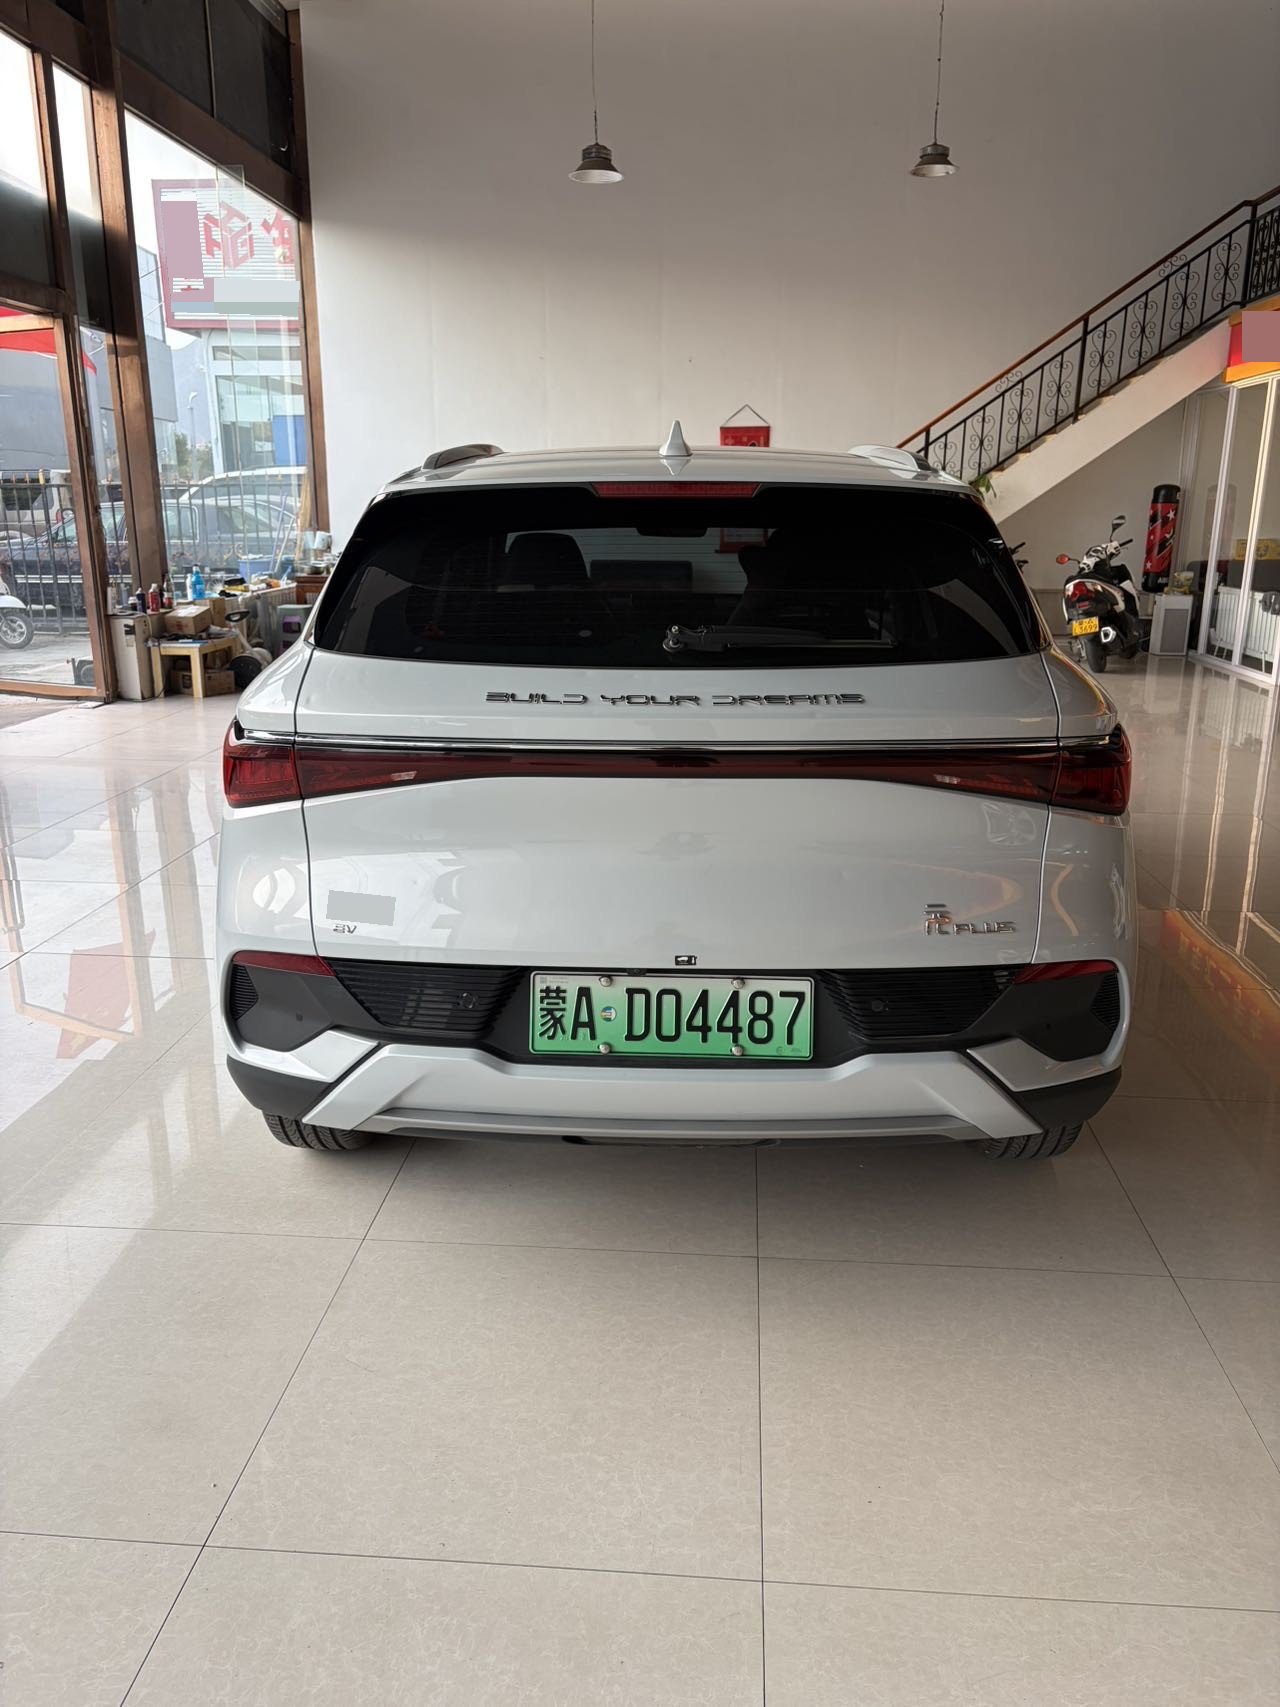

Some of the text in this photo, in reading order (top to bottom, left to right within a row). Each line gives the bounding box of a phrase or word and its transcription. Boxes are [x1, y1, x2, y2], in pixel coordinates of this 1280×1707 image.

[486, 691, 867, 706] BUILD YOUR DREAMS
[953, 921, 1017, 935] PLUS
